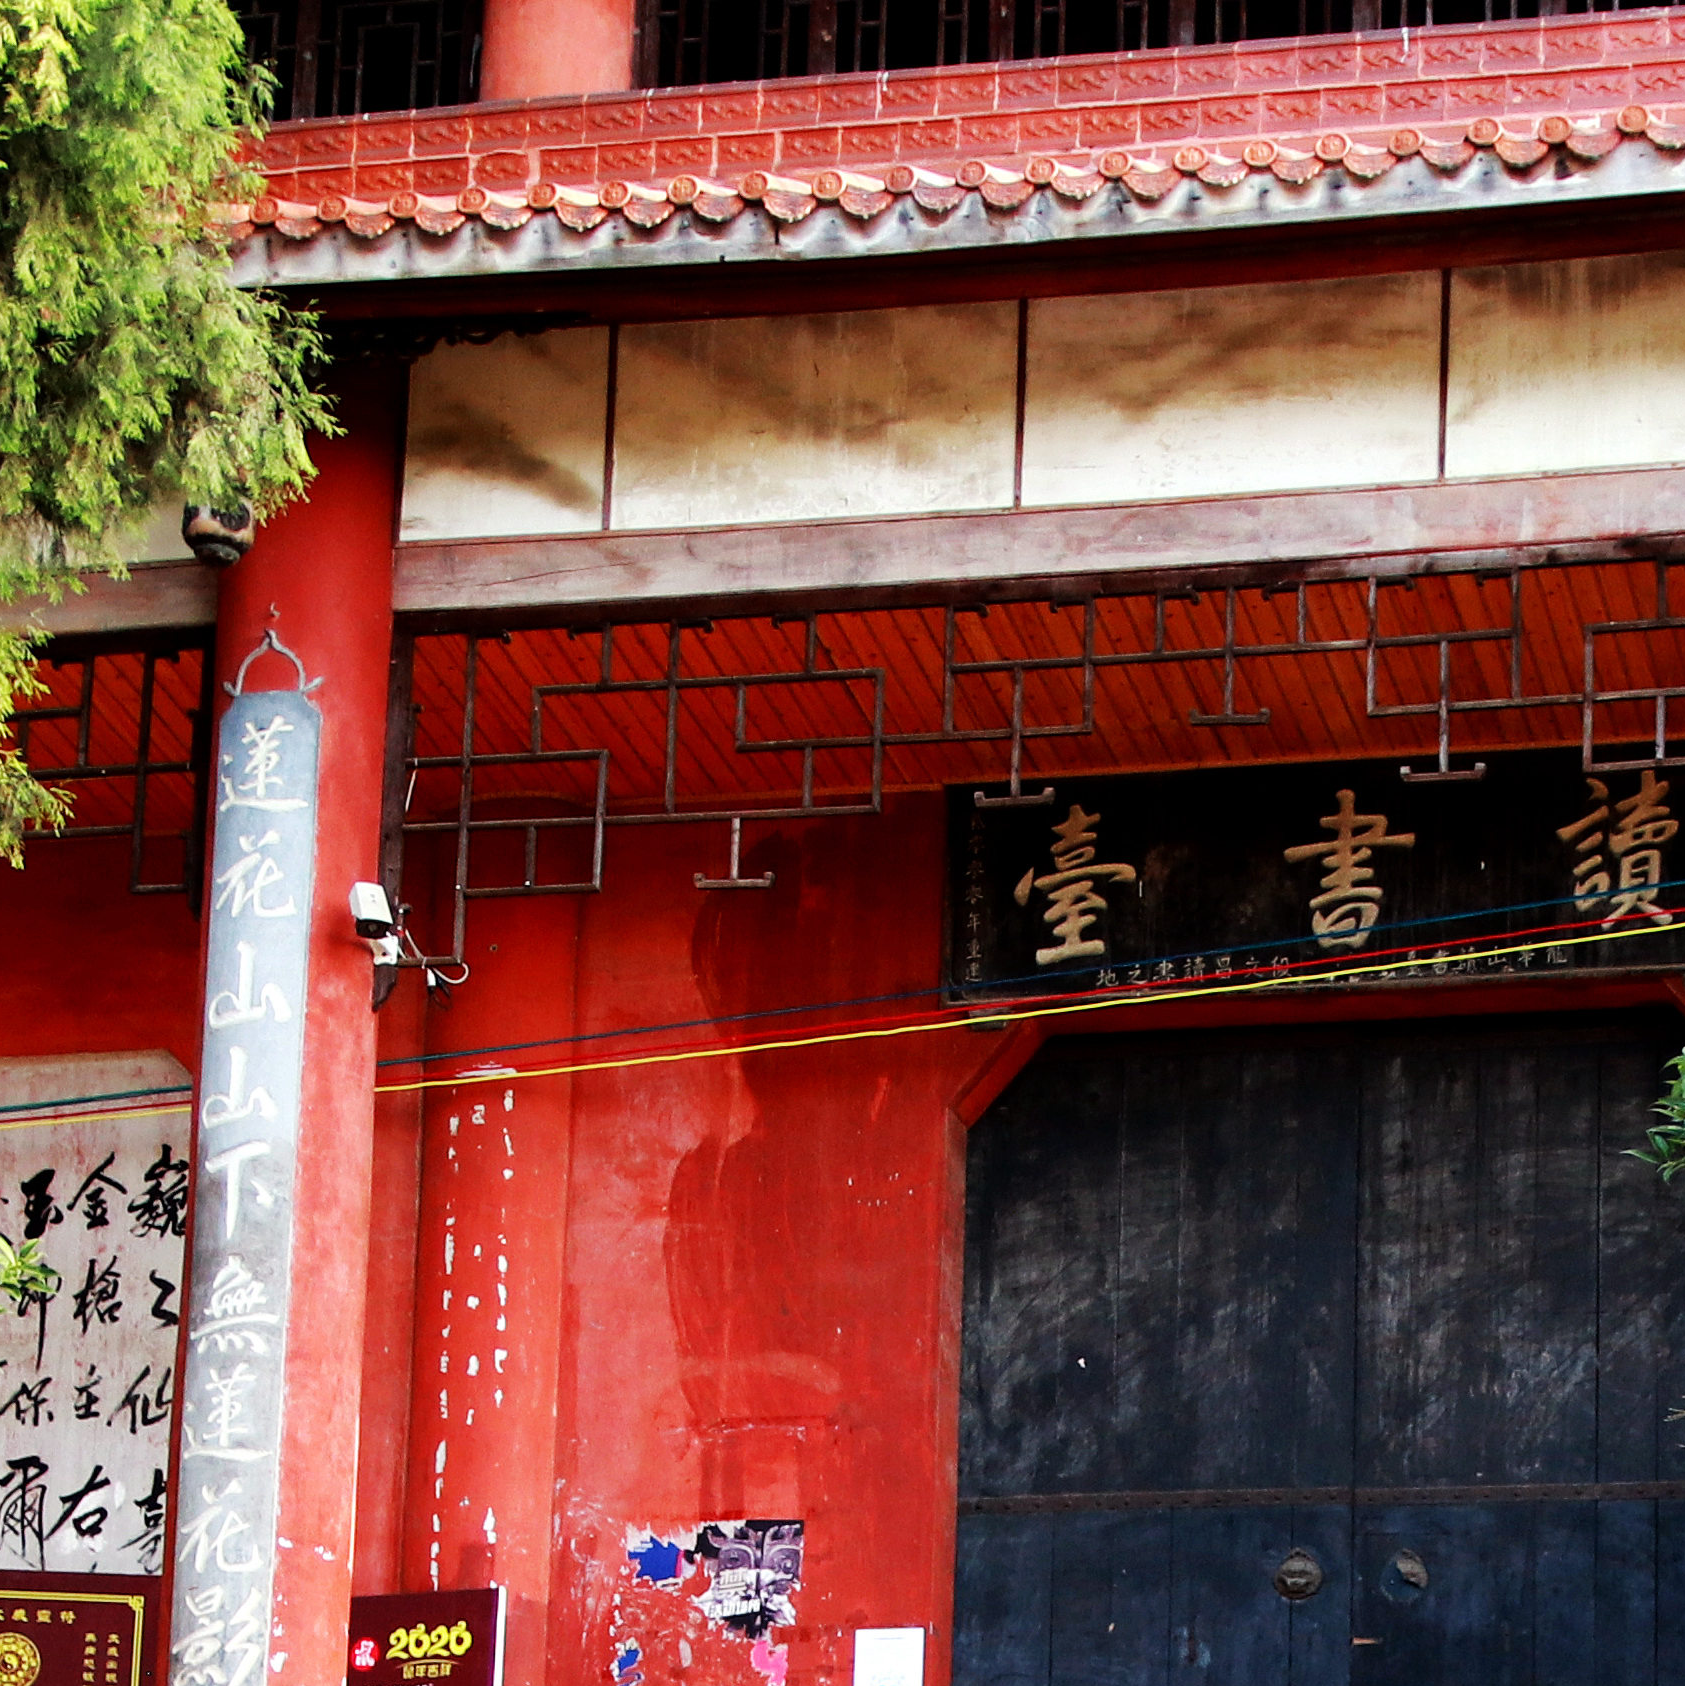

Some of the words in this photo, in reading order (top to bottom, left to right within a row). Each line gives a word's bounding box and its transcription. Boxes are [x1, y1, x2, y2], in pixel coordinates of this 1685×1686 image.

[1013, 770, 1680, 966] 讀書臺
[385, 1620, 473, 1660] 2020
